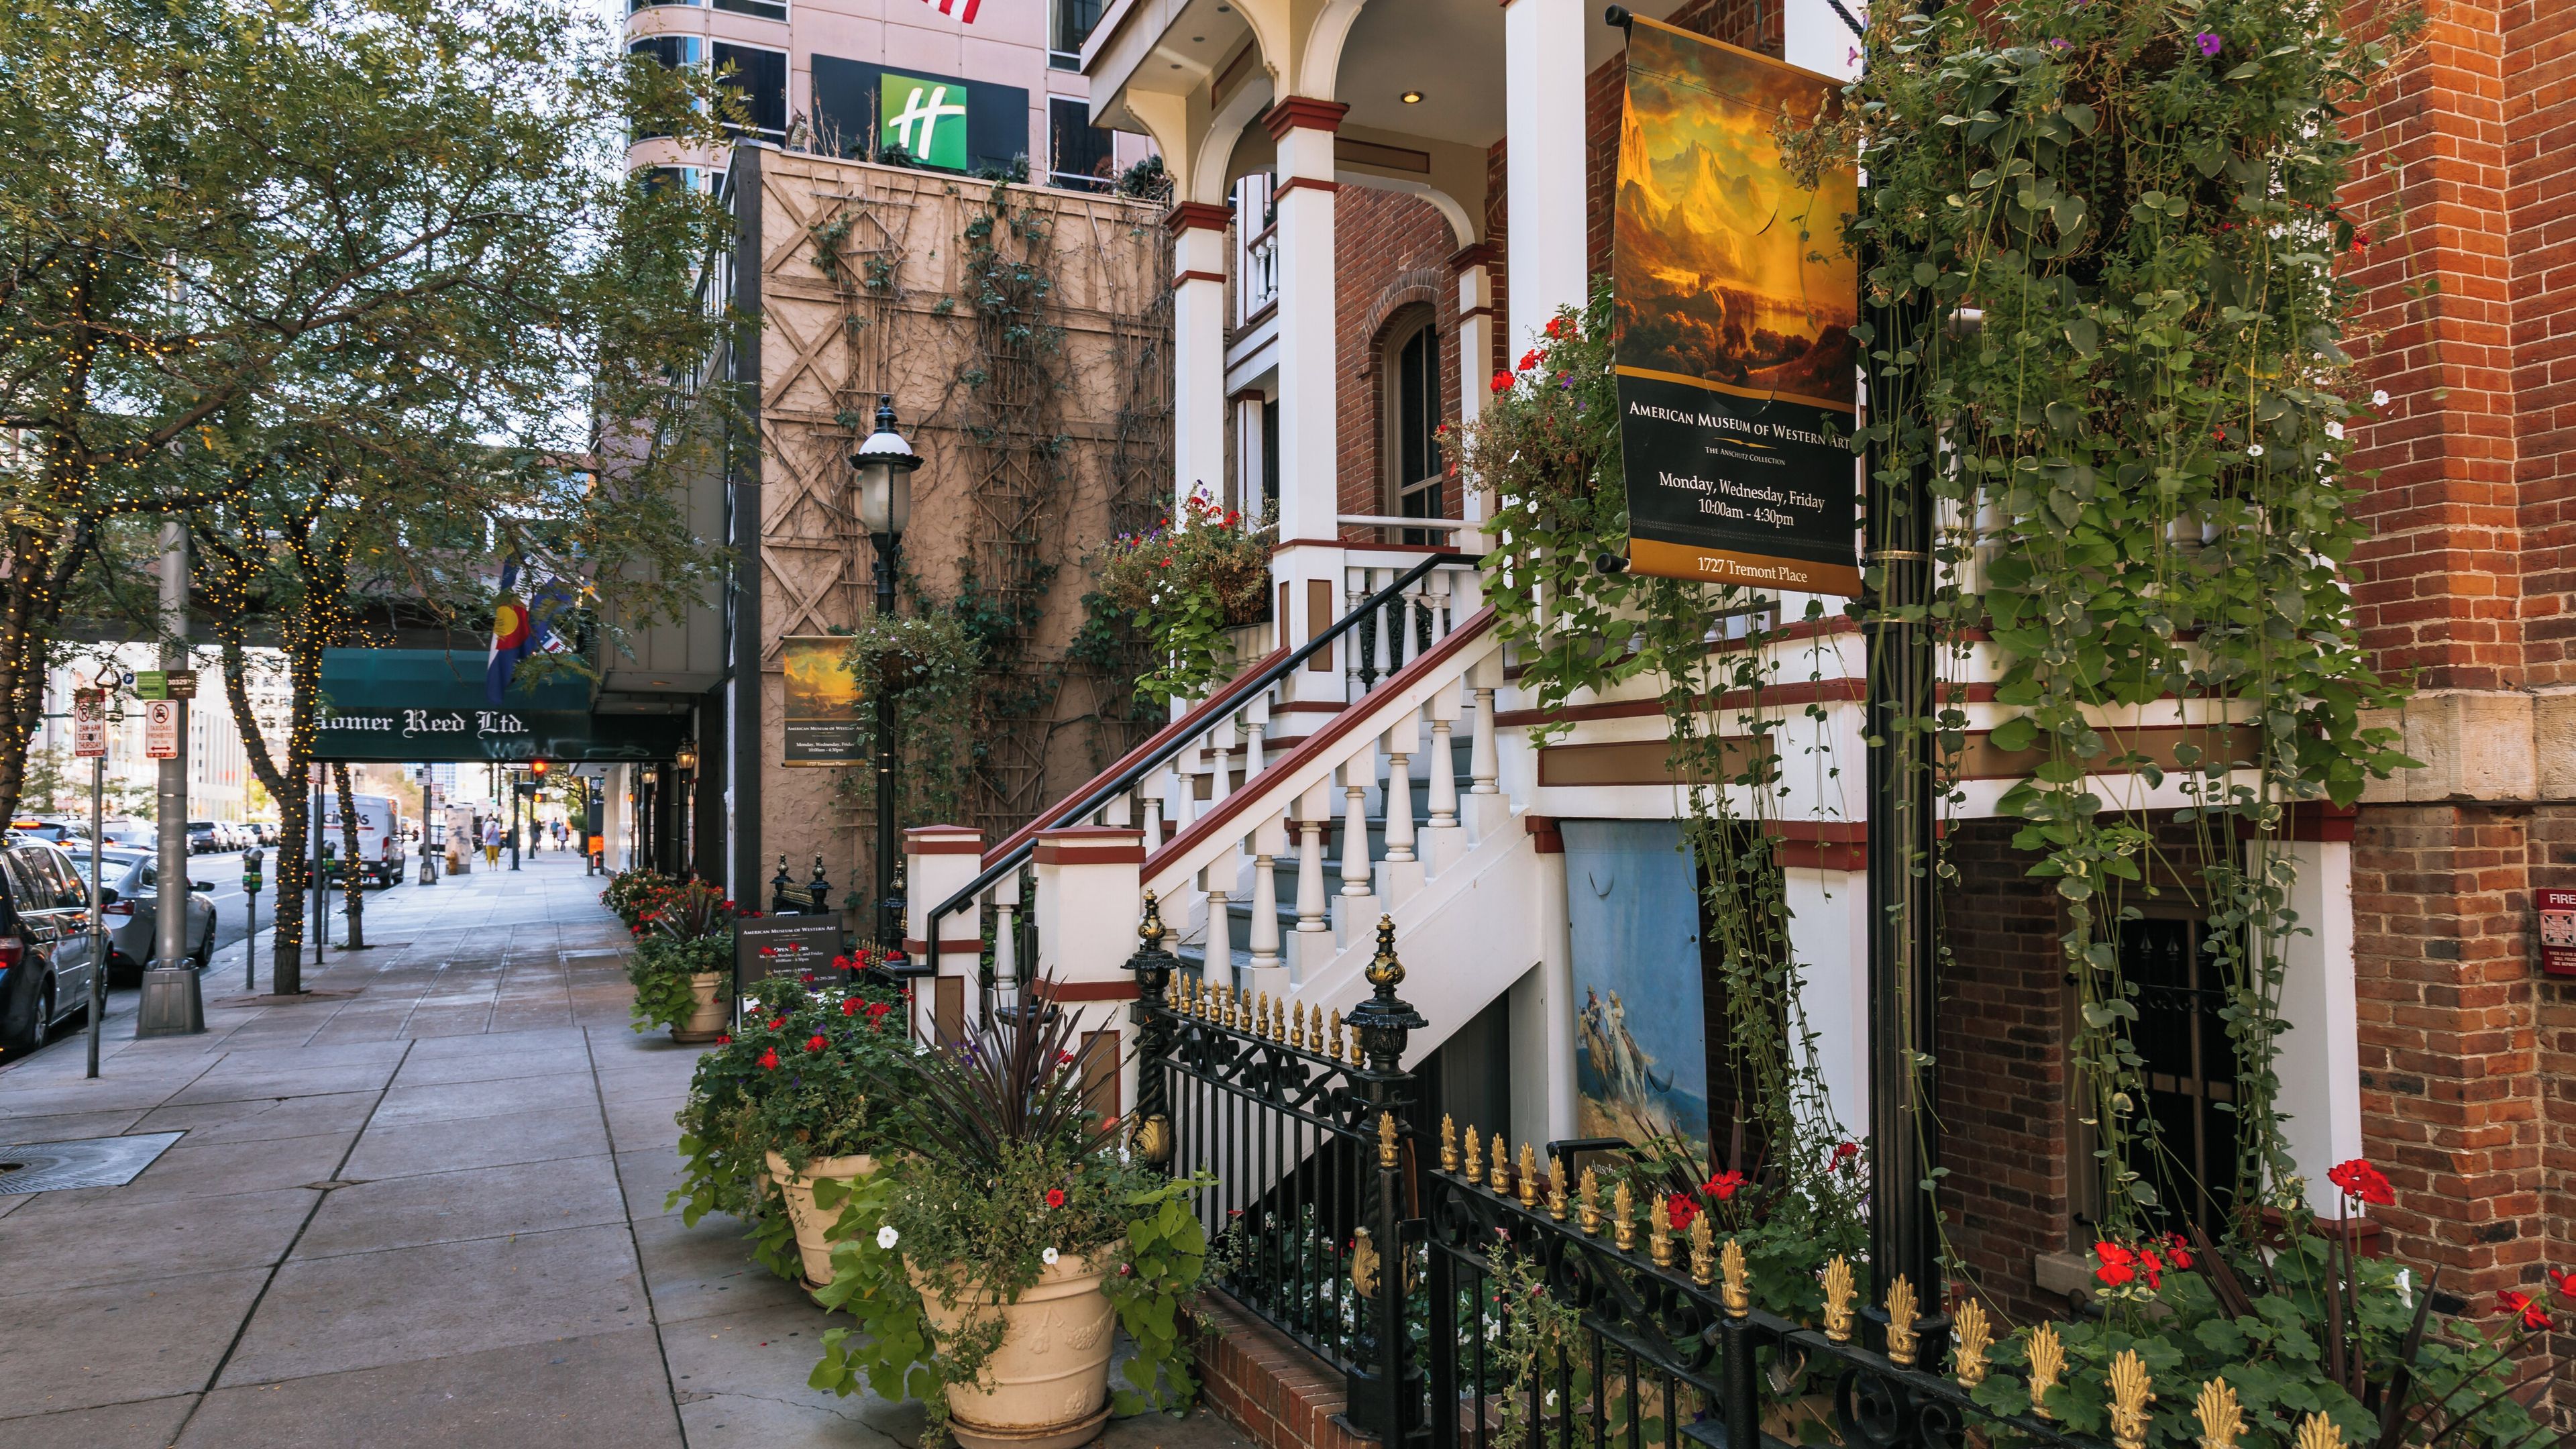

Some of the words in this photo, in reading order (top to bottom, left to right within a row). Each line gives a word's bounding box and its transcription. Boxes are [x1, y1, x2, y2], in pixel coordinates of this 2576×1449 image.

[1629, 400, 1694, 425] AMERICAN
[1698, 413, 1751, 433] MUSEUM
[1754, 424, 1769, 436] OF
[1772, 423, 1826, 445] WESTERN
[1705, 446, 1719, 454] THE
[1720, 448, 1748, 460] ANSCHUTZ
[1749, 453, 1786, 466] COLLECTION
[1658, 471, 1717, 495] Monday,
[1719, 478, 1787, 507] Wednesday,
[1788, 490, 1825, 513] Friday
[1698, 498, 1744, 519] 10:00am
[1754, 507, 1794, 529] 4:30pm
[1697, 557, 1725, 573] 1727
[1726, 559, 1776, 580] Tremont
[1778, 566, 1808, 583] Place
[78, 733, 97, 741] TUESY
[402, 709, 466, 739] Reed
[476, 710, 530, 739] Ltd.
[2549, 894, 2576, 904] FIRE
[1591, 1159, 1615, 1176] Ansch
